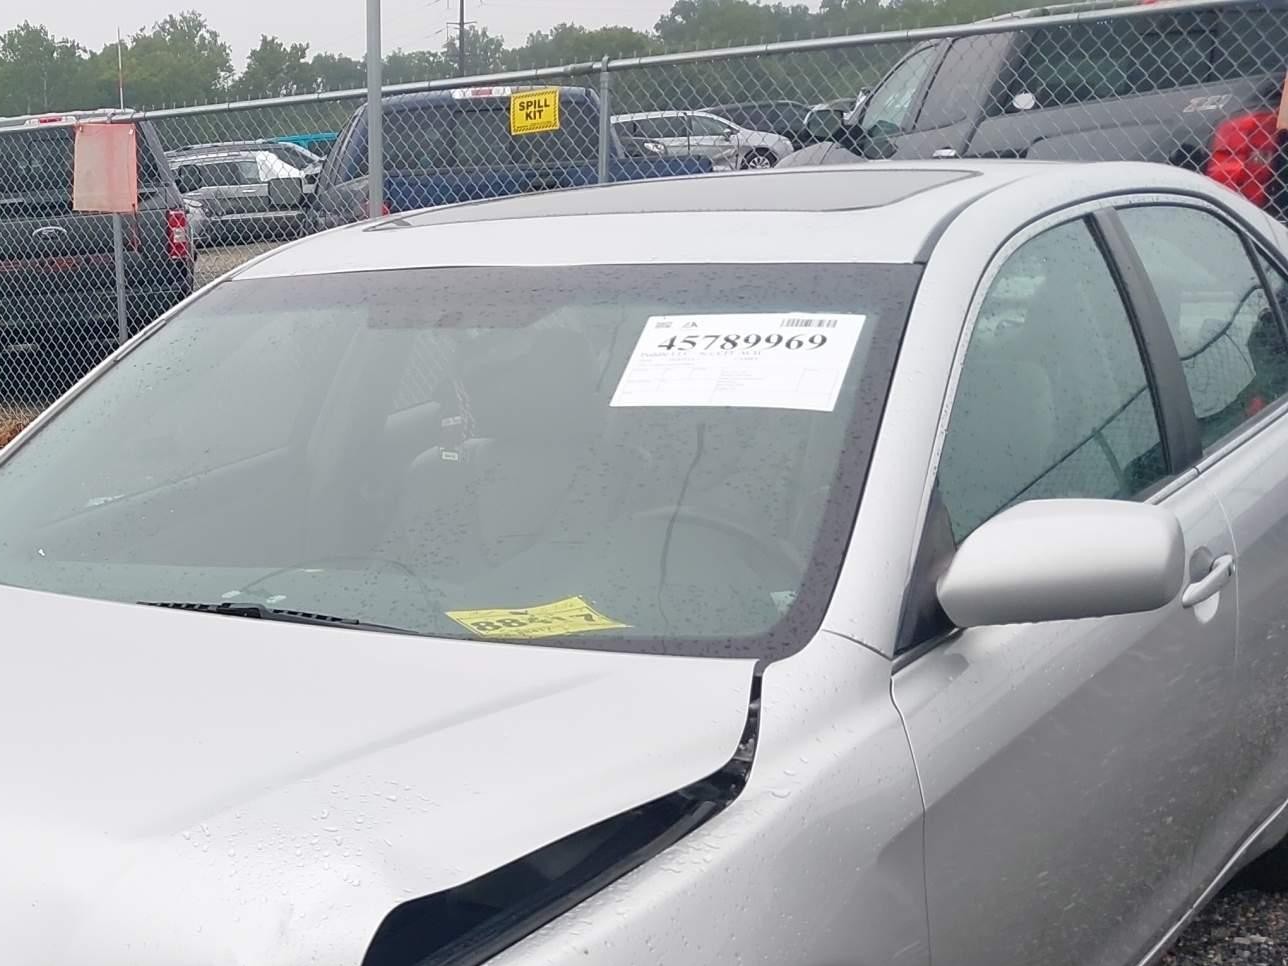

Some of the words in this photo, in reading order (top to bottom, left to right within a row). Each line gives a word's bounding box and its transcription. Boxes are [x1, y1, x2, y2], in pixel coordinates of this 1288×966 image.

[518, 98, 551, 112] SPILL
[525, 109, 543, 121] KIT
[657, 333, 828, 351] 45789969
